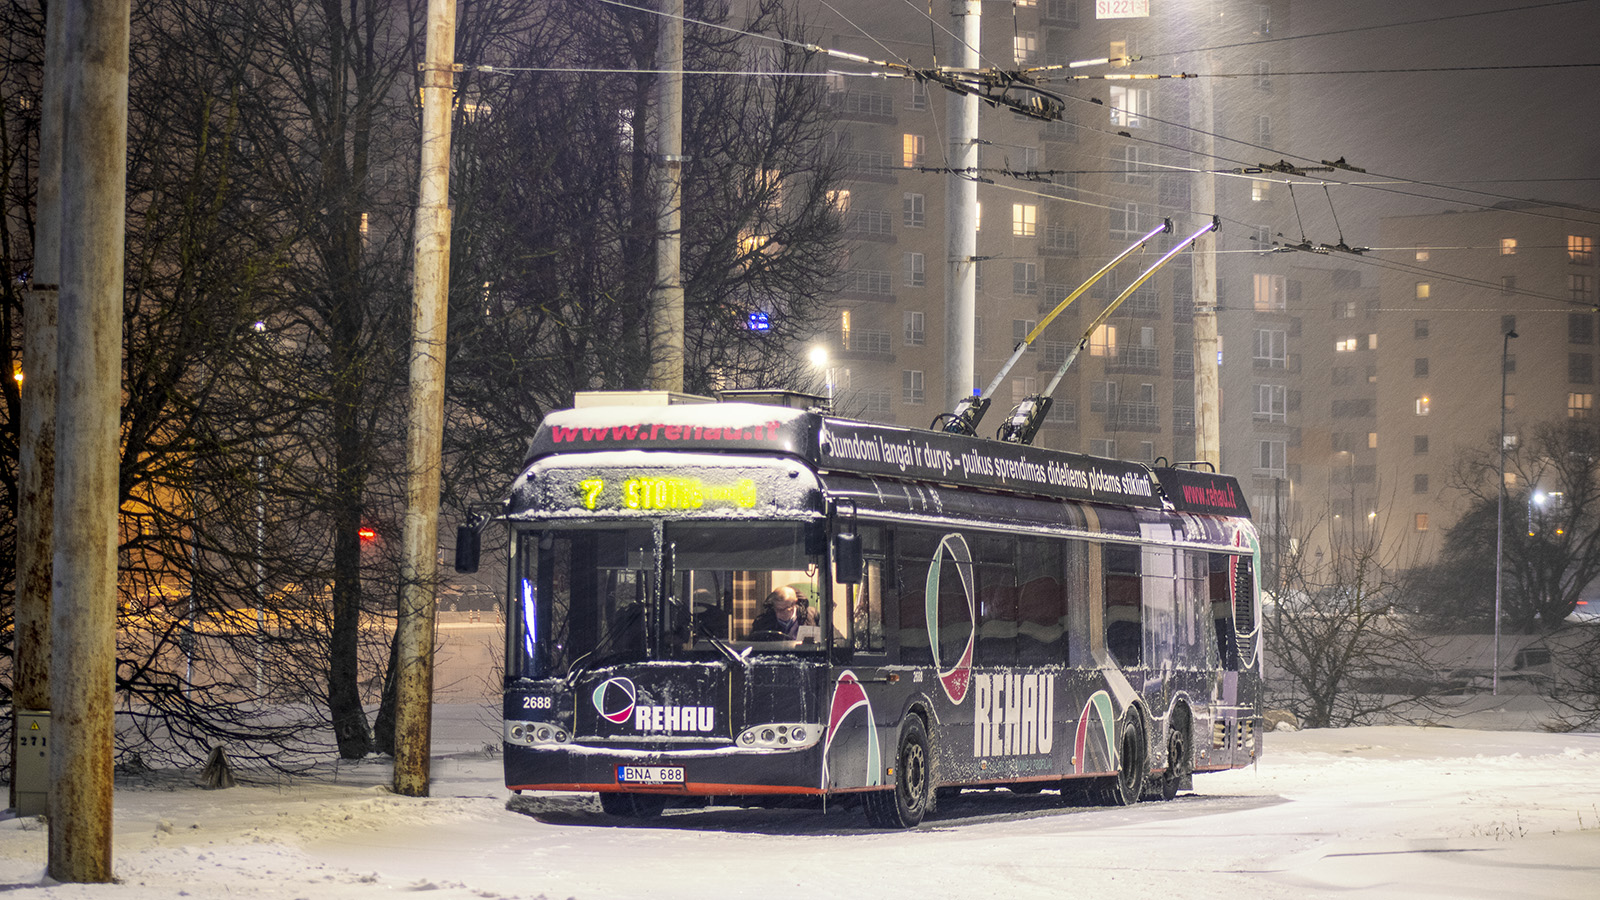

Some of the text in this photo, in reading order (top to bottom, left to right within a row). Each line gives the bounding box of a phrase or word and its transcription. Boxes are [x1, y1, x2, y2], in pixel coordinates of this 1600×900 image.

[825, 429, 880, 462] Stumdomi
[880, 435, 912, 472] langai
[913, 440, 922, 467] ir
[924, 442, 953, 476] durys
[961, 449, 993, 479] puikus
[994, 456, 1047, 484] sprendimas
[1047, 460, 1088, 489] dideliems
[1088, 466, 1122, 496] plotams
[1121, 471, 1152, 497] stiklinti
[582, 479, 604, 509] 7
[1182, 480, 1237, 510] www.rehau.lt
[522, 696, 551, 709] 2688
[973, 673, 1054, 758] REHAU
[635, 705, 714, 732] REHAU
[626, 768, 652, 780] BNA
[660, 769, 682, 781] 688
